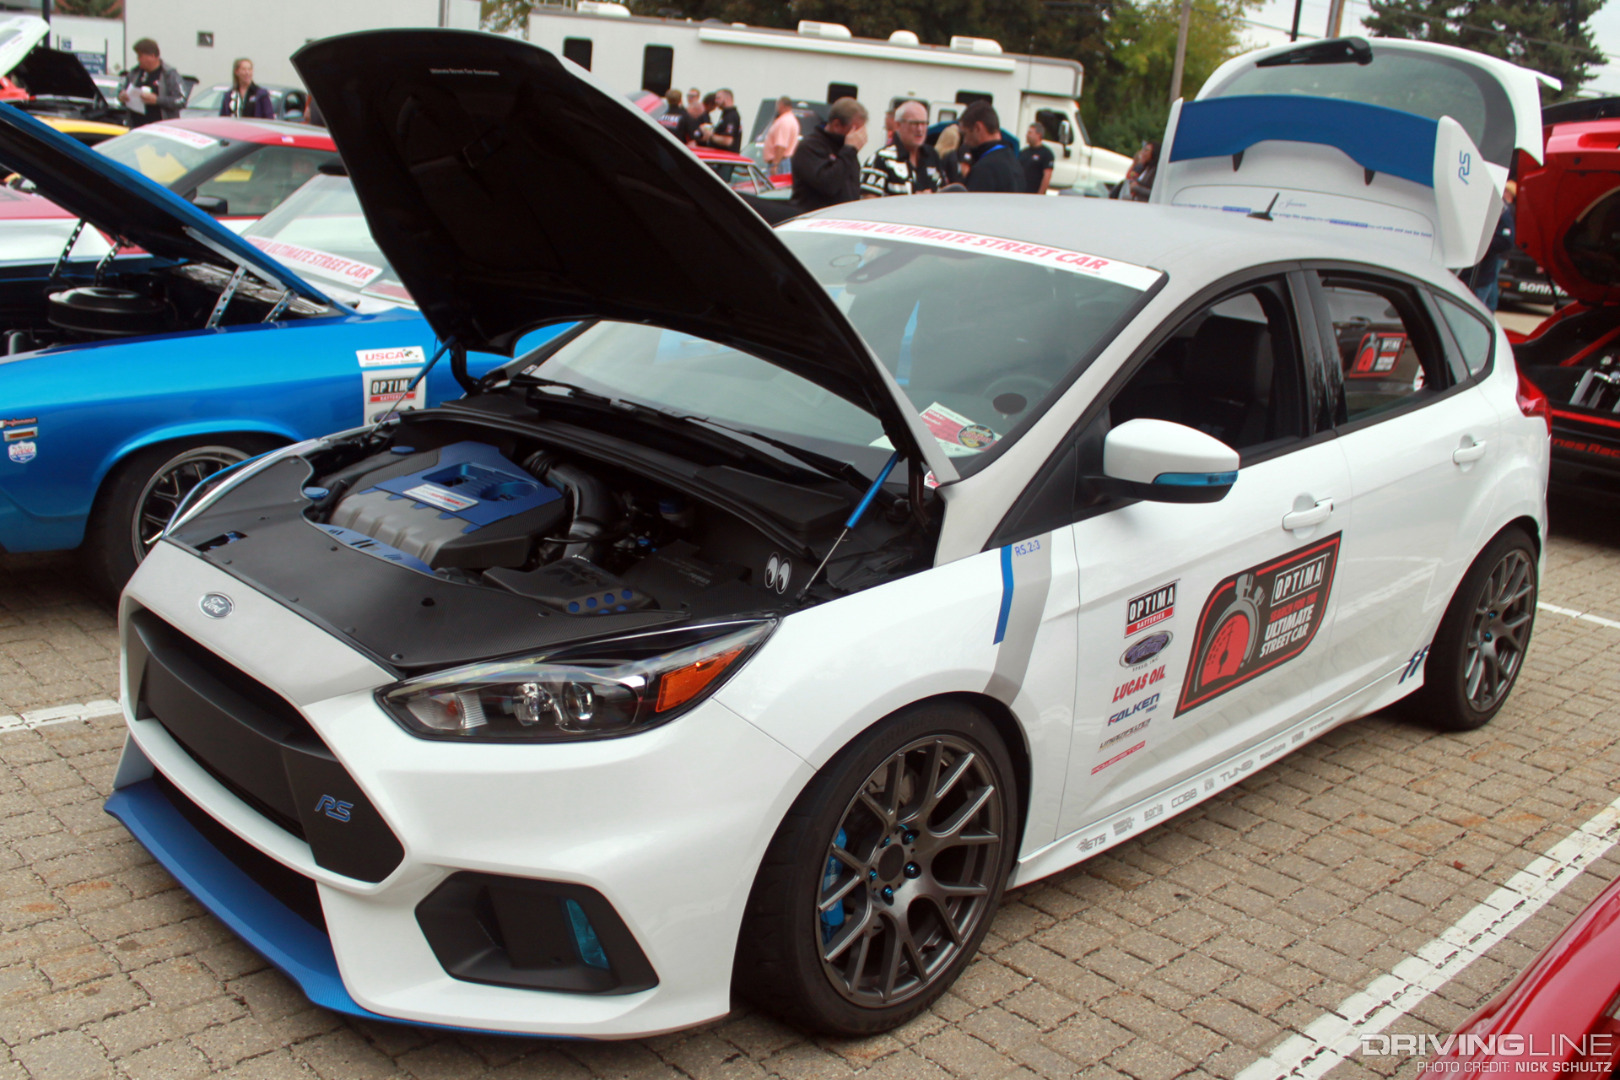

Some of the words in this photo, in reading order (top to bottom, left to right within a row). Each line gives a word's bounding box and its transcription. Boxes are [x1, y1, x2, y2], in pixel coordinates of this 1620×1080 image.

[1458, 150, 1471, 185] RS
[874, 223, 977, 244] ULTIMATE
[971, 238, 1059, 259] STREET
[1055, 252, 1110, 271] CAR
[308, 254, 349, 273] STREET
[345, 264, 375, 281] CAR
[364, 351, 405, 361] USCA
[1275, 560, 1323, 601] OPTIMA
[202, 597, 227, 614] Ford
[1128, 586, 1174, 622] OPTIMA
[1136, 611, 1166, 630] BATTERIES
[1264, 603, 1315, 642] ULTIMATE
[1259, 631, 1291, 659] STREET
[1290, 622, 1310, 643] CAR
[1111, 672, 1149, 704] LUCAS
[1148, 664, 1167, 686] OIL
[1107, 692, 1161, 727] FALKEN
[314, 794, 355, 823] RS
[1171, 787, 1198, 809] COBB
